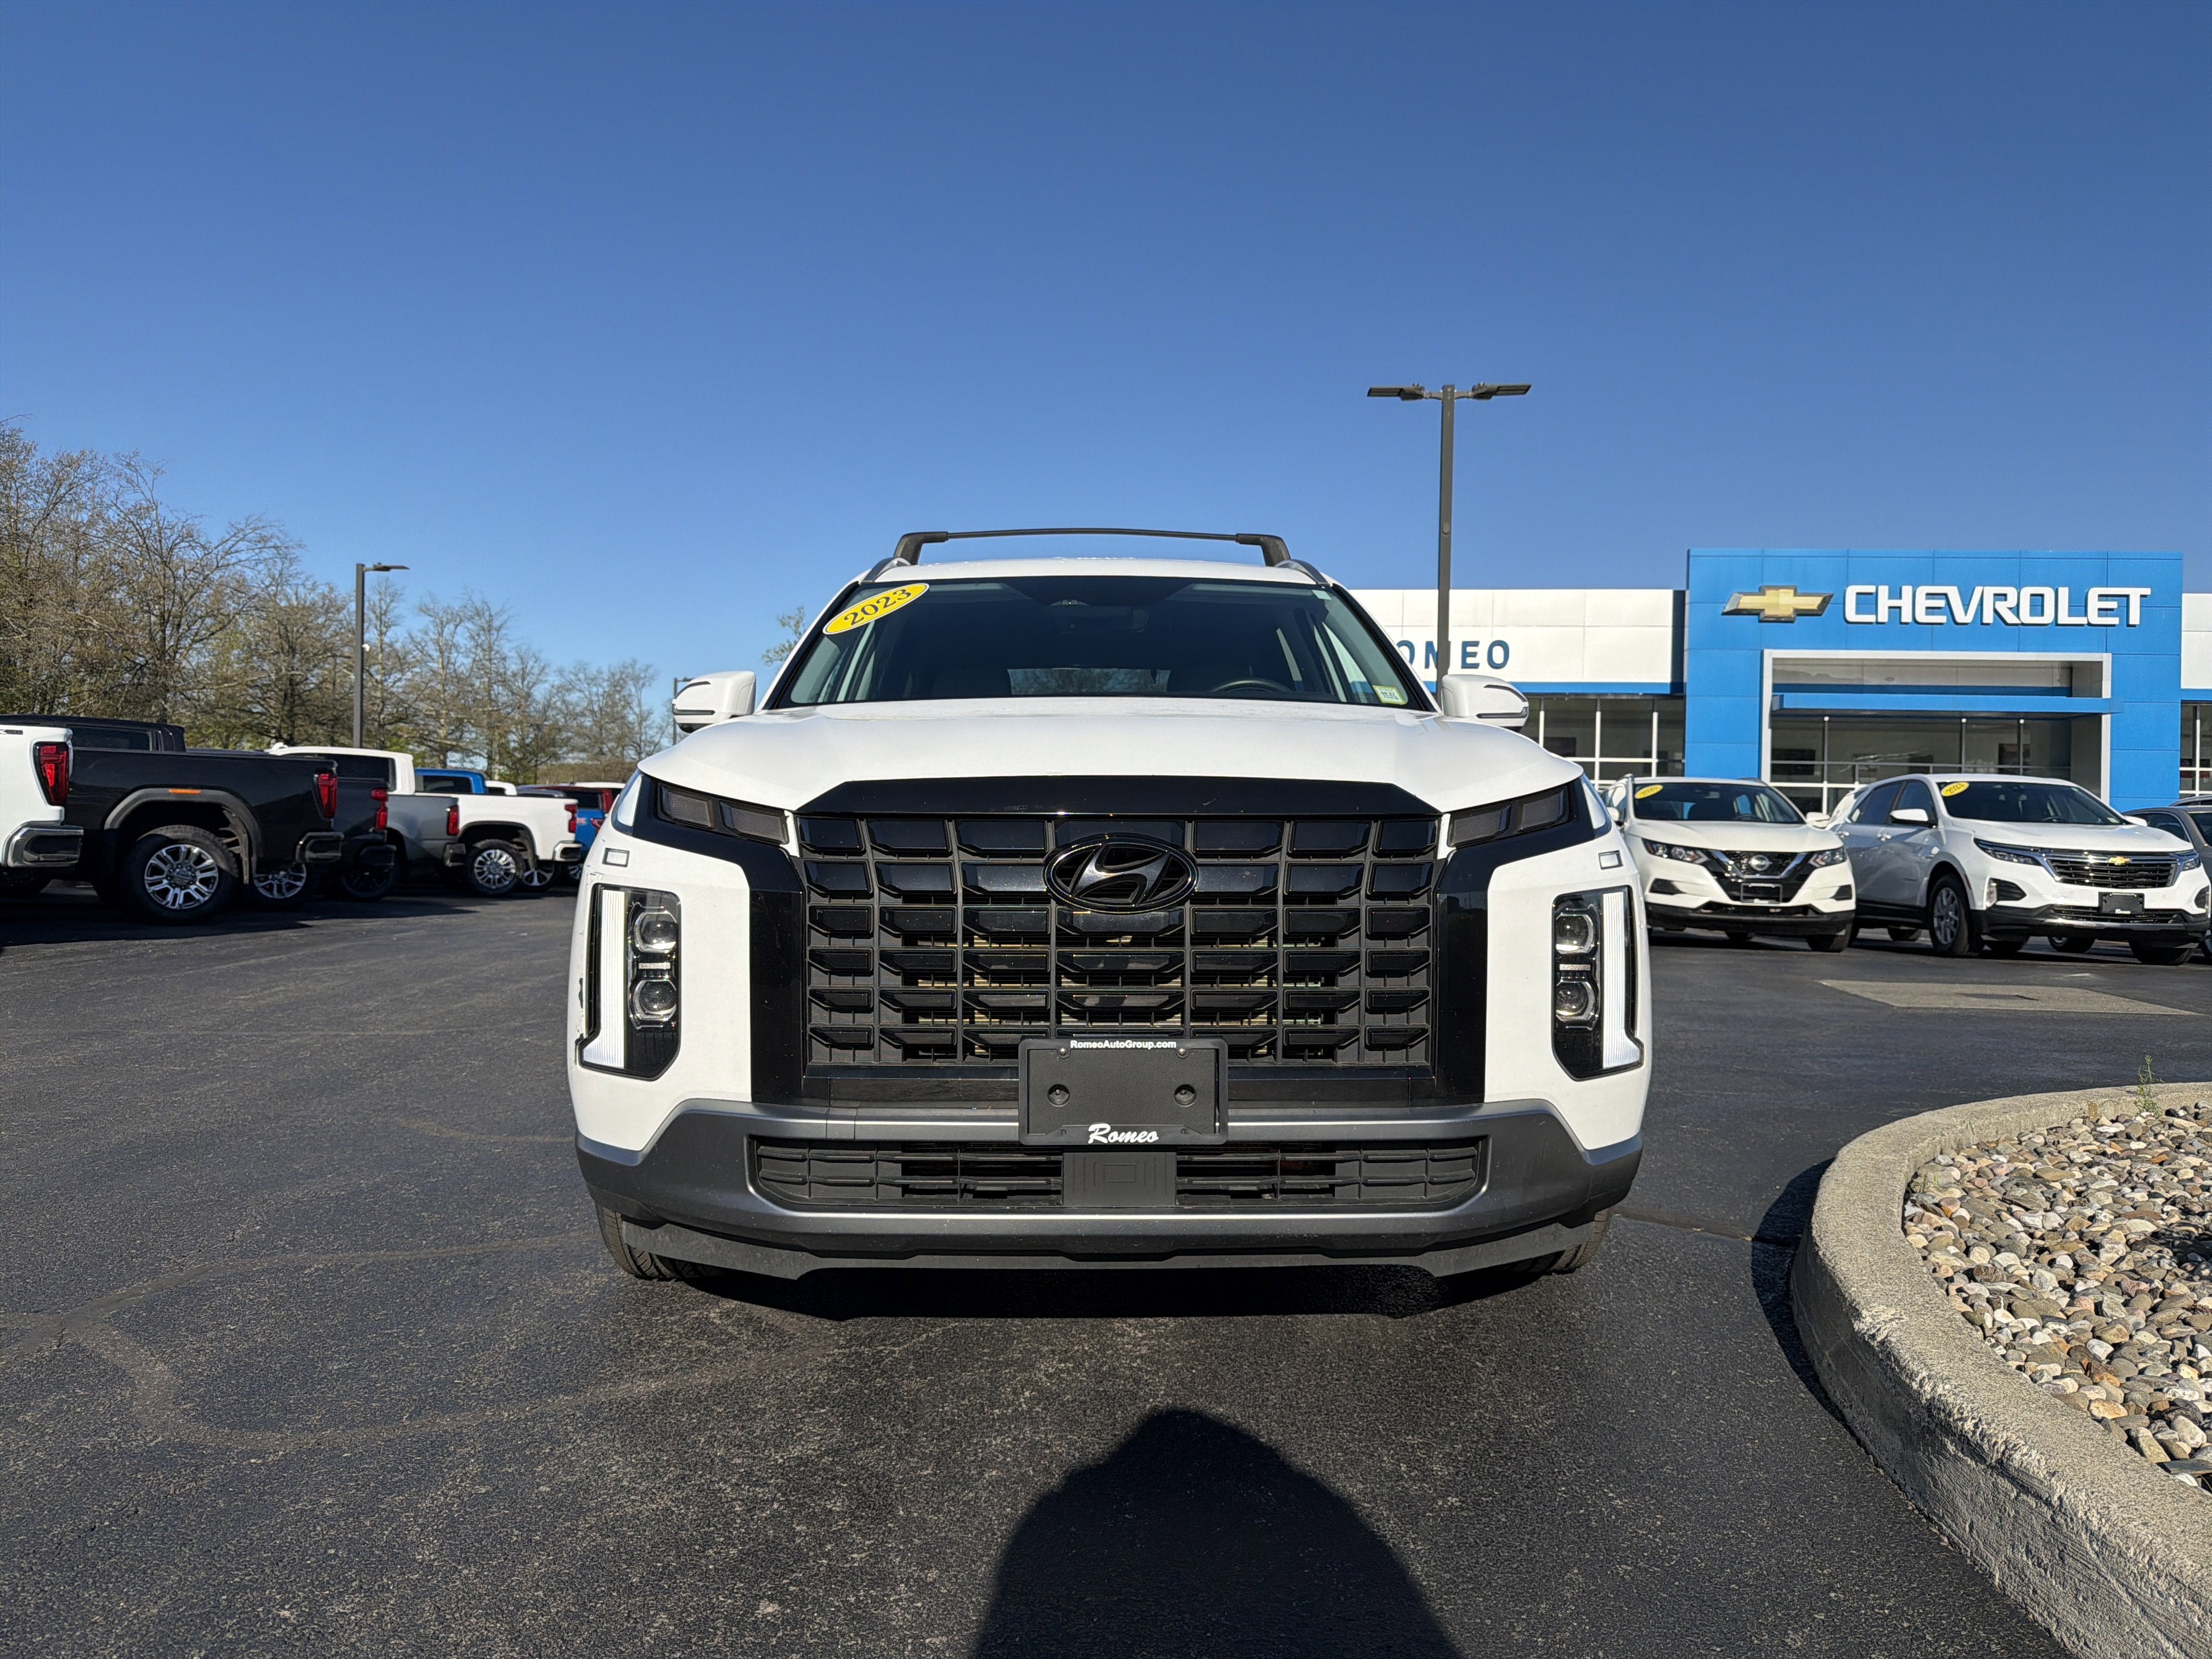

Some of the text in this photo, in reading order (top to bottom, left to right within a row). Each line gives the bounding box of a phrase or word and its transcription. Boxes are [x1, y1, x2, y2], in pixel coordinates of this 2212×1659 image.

[844, 589, 911, 625] 2023
[1844, 585, 2151, 626] CHEVROLET
[1070, 1040, 1177, 1049] RomeoAutoGroup.com
[1088, 1123, 1159, 1144] Romeo
